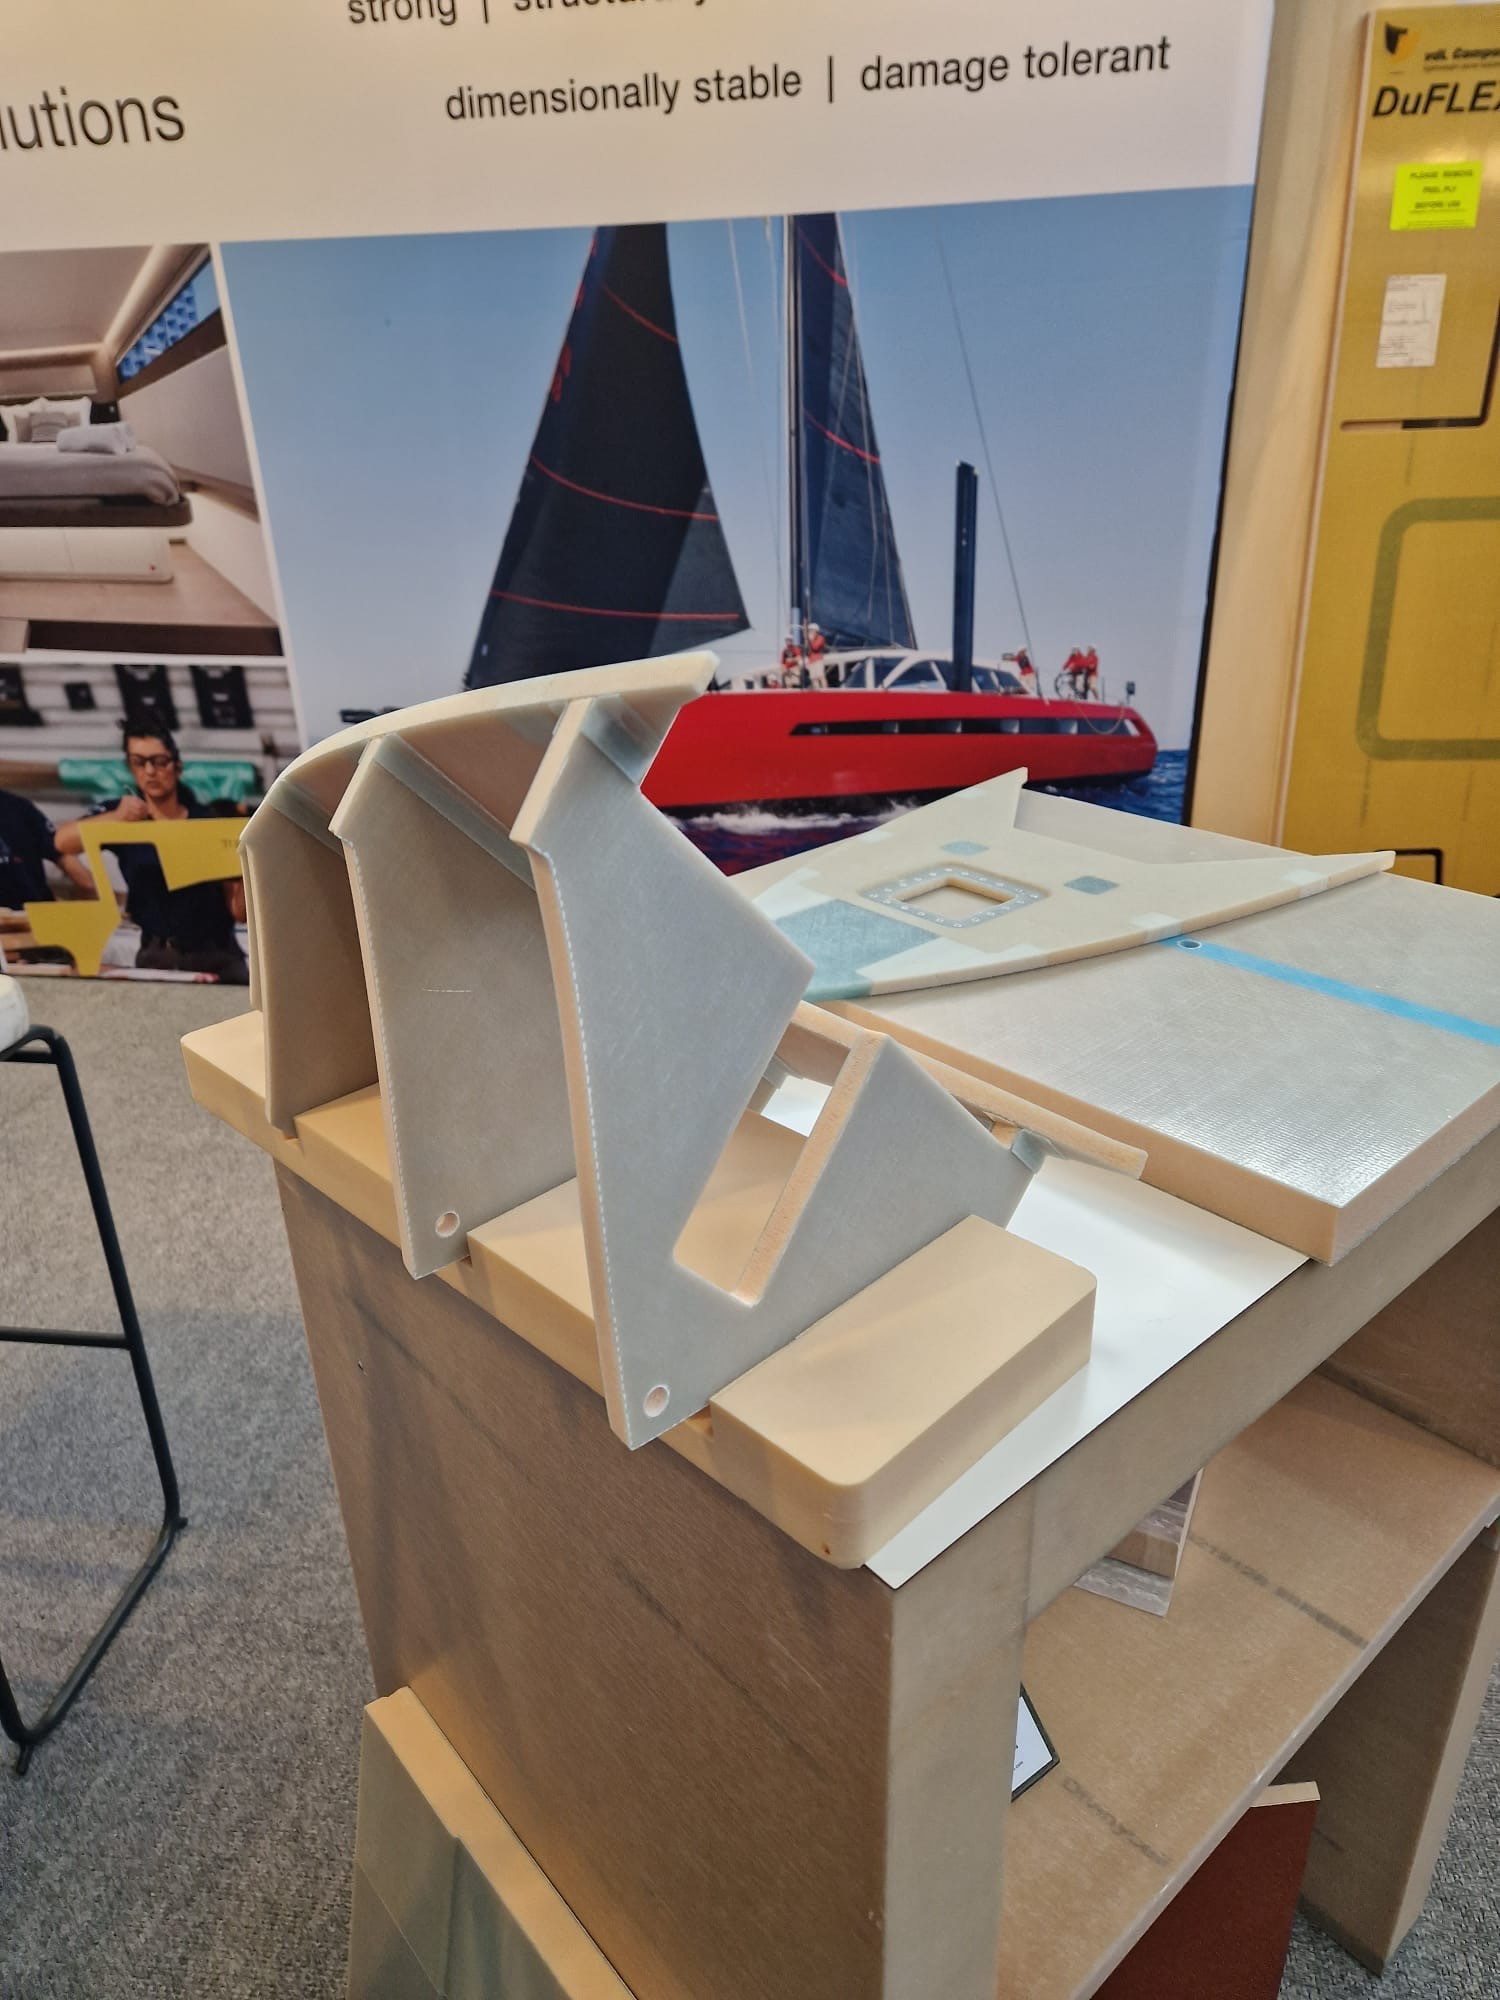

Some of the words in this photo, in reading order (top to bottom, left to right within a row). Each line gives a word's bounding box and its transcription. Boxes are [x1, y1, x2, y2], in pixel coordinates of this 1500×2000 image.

[348, 0, 457, 26] strong
[446, 71, 680, 119] dimensionally
[693, 63, 802, 103] stable
[861, 54, 1009, 92] damage
[1024, 36, 1171, 79] tolerant
[1372, 80, 1500, 118] DuFLE
